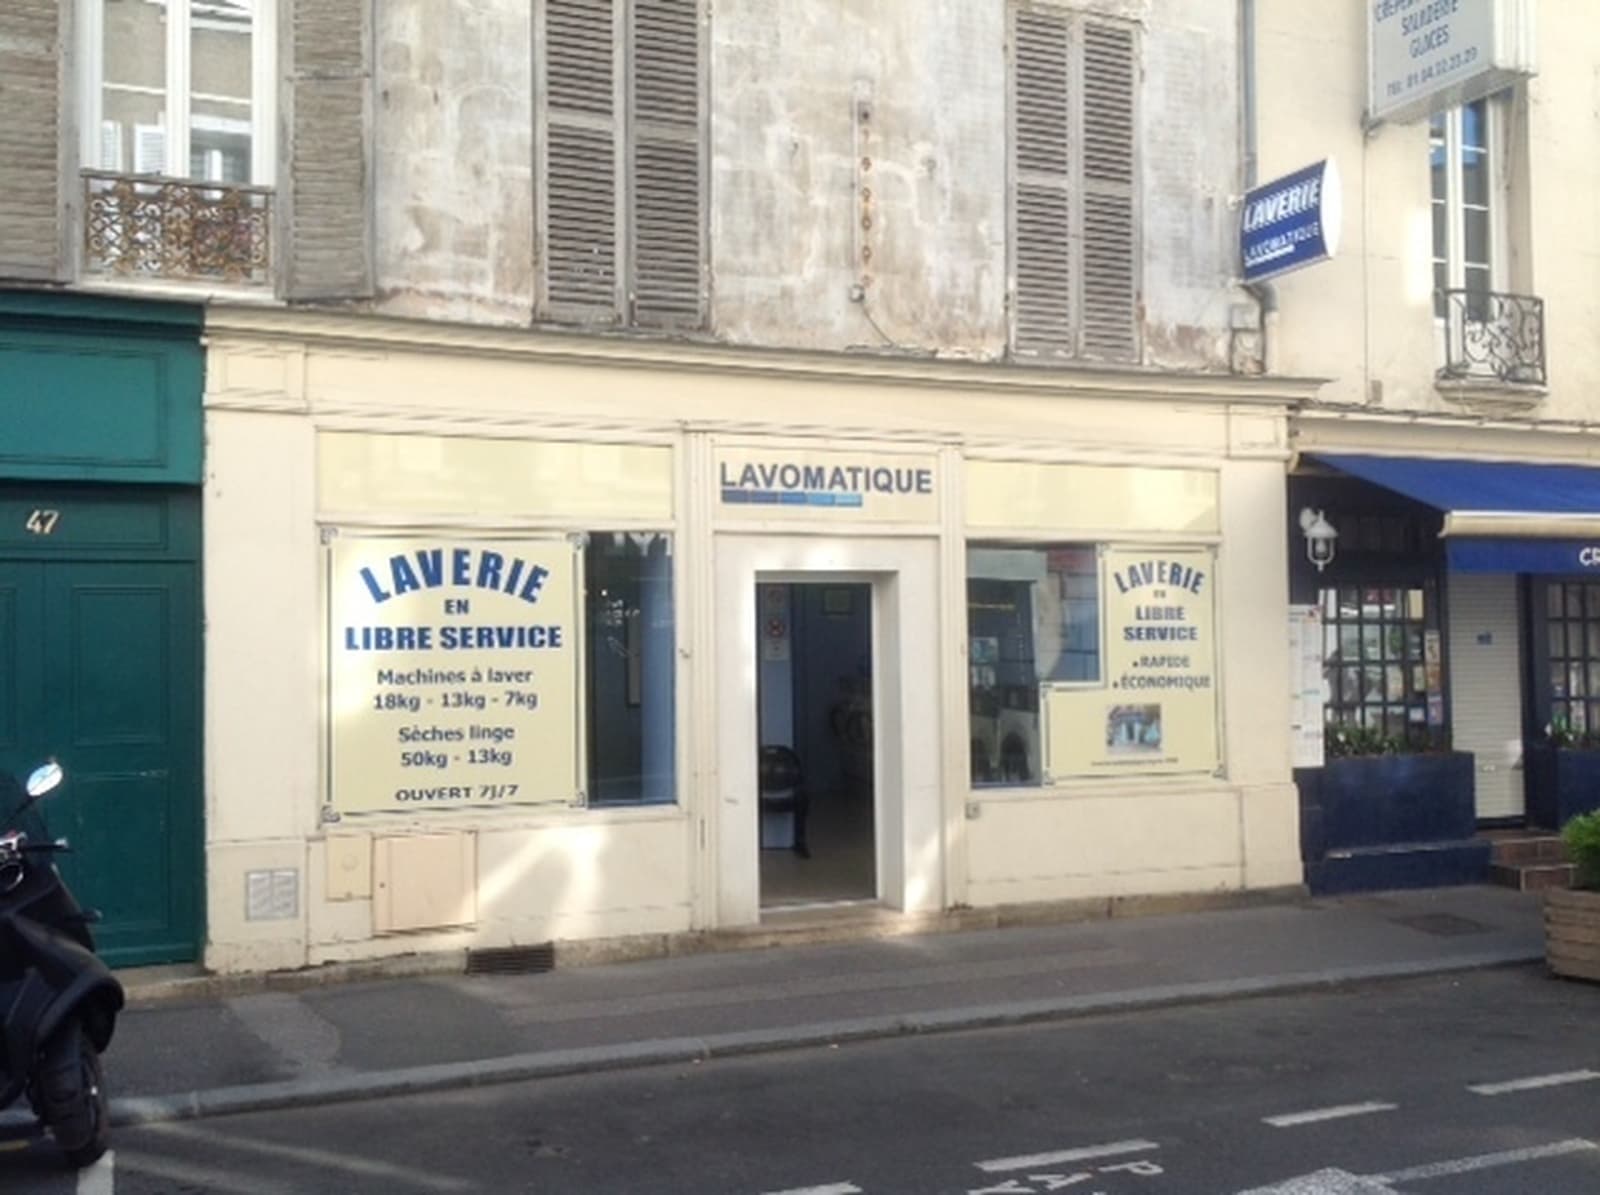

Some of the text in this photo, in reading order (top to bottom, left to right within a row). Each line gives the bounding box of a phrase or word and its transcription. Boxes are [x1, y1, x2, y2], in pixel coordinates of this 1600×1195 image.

[1244, 178, 1319, 232] LAVERIE
[720, 461, 932, 493] LAVOMATIQUE
[26, 510, 59, 534] 47
[360, 548, 549, 603] LAVERIE
[1114, 561, 1204, 594] LAVERIE
[444, 600, 469, 614] EN
[1136, 605, 1185, 620] LIBRE
[345, 626, 562, 650] LIBRE SERVICE
[1124, 627, 1197, 640] SERVICE
[1140, 656, 1190, 668] RAPIDE
[377, 668, 532, 685] Machines à laver
[1121, 673, 1210, 691] ÉCONOMIQUE
[374, 694, 420, 711] 18kg
[442, 693, 486, 709] 13kg
[504, 691, 538, 709] 7kg
[399, 725, 515, 743] Sèches linge
[401, 750, 448, 768] 50kg
[468, 749, 513, 766] 13kg
[395, 787, 472, 801] OUVERT
